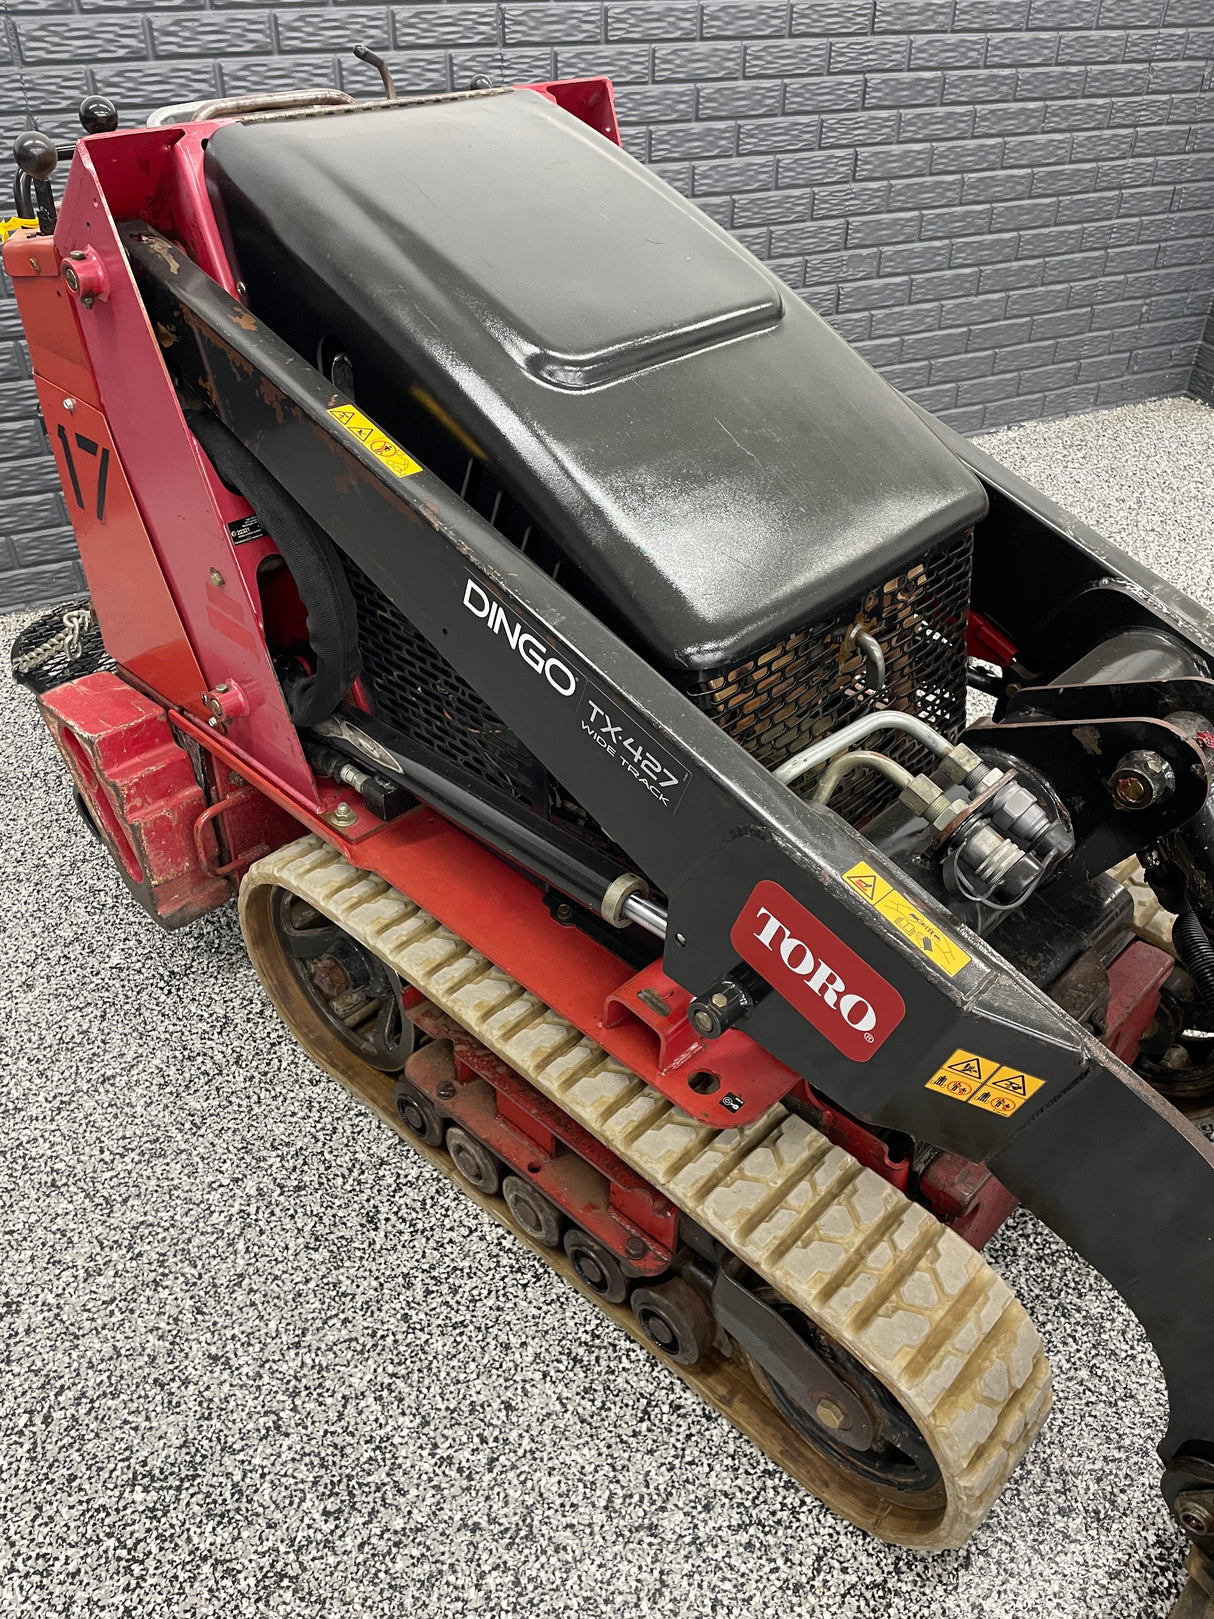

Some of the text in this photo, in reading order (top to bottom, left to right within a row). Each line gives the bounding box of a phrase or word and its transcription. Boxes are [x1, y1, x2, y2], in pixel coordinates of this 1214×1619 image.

[57, 424, 109, 521] 17
[462, 578, 576, 697] DINGO
[580, 720, 669, 806] WIDE TRACK
[753, 906, 877, 1032] TORO
